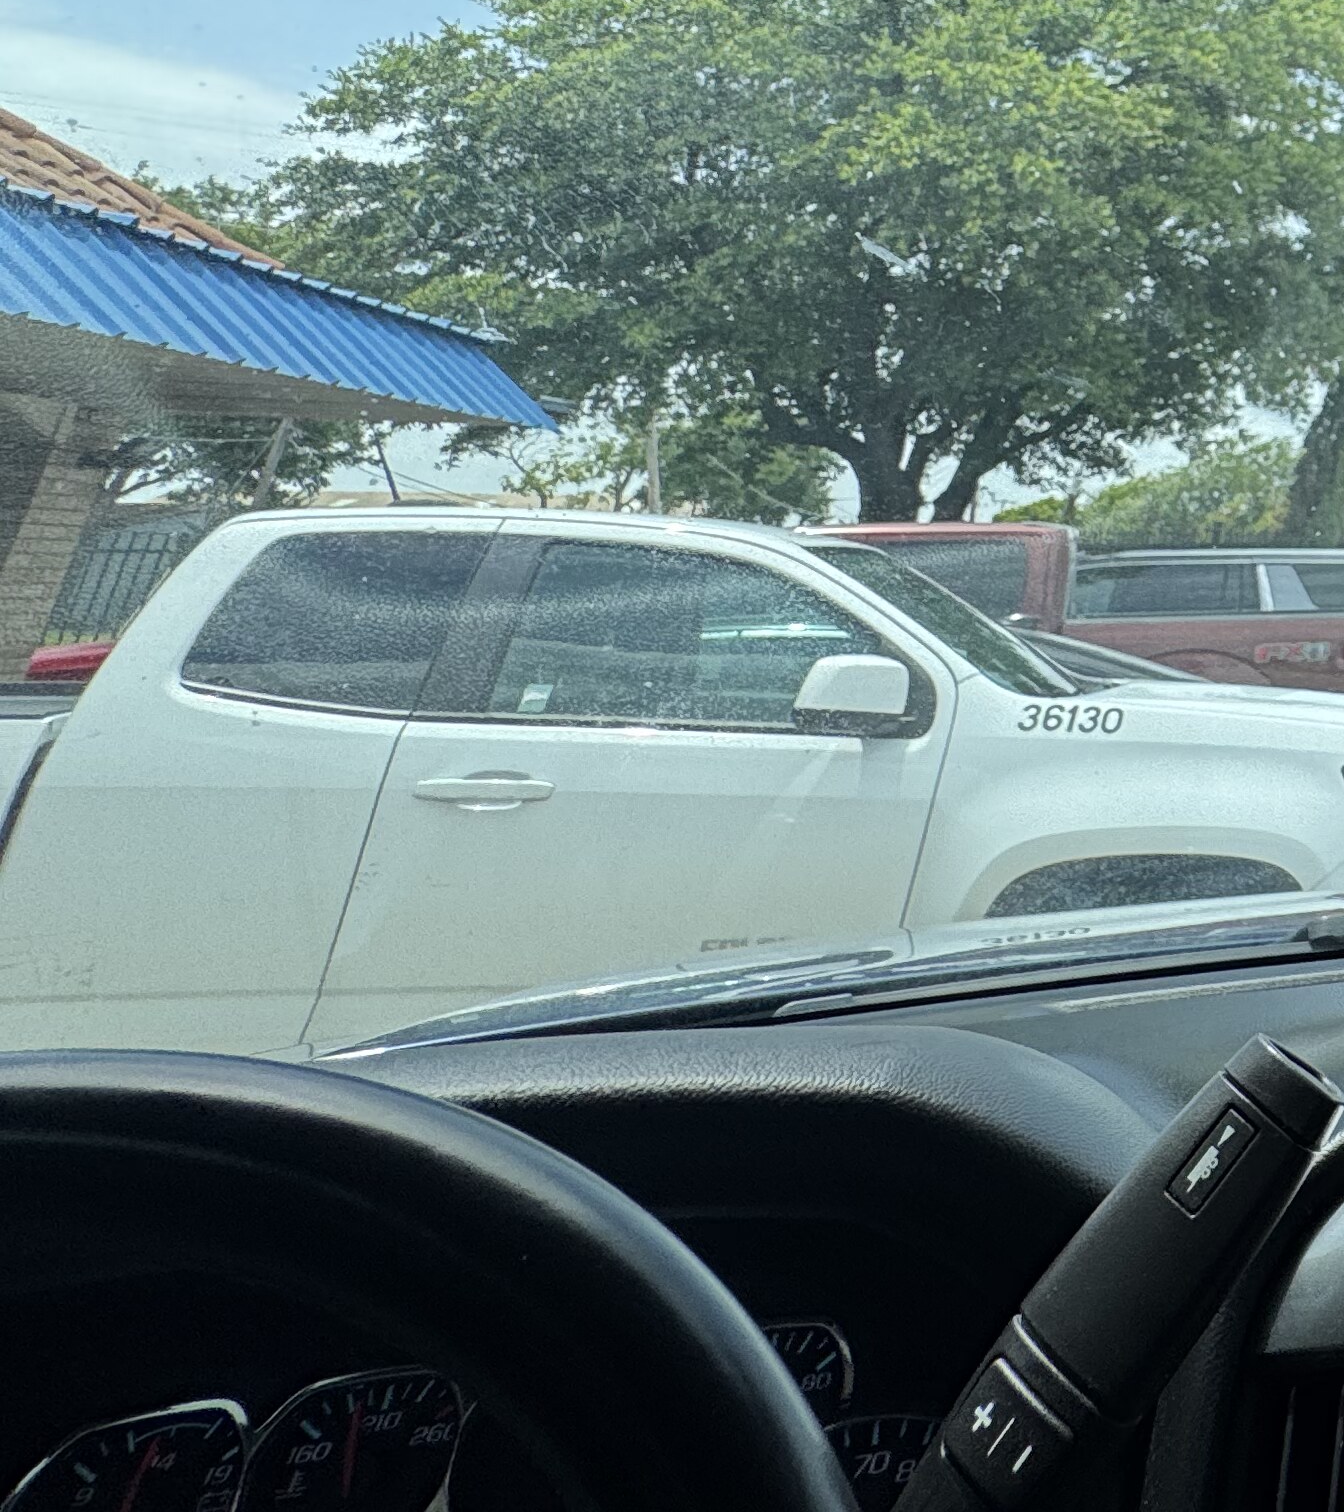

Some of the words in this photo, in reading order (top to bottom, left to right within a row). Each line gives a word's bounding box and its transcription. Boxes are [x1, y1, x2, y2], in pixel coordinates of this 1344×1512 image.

[1017, 704, 1124, 734] 36130
[287, 1443, 332, 1465] 160
[854, 1450, 893, 1480] 70
[204, 1464, 234, 1486] 19
[894, 1458, 917, 1483] 8
[72, 1487, 95, 1507] 9
